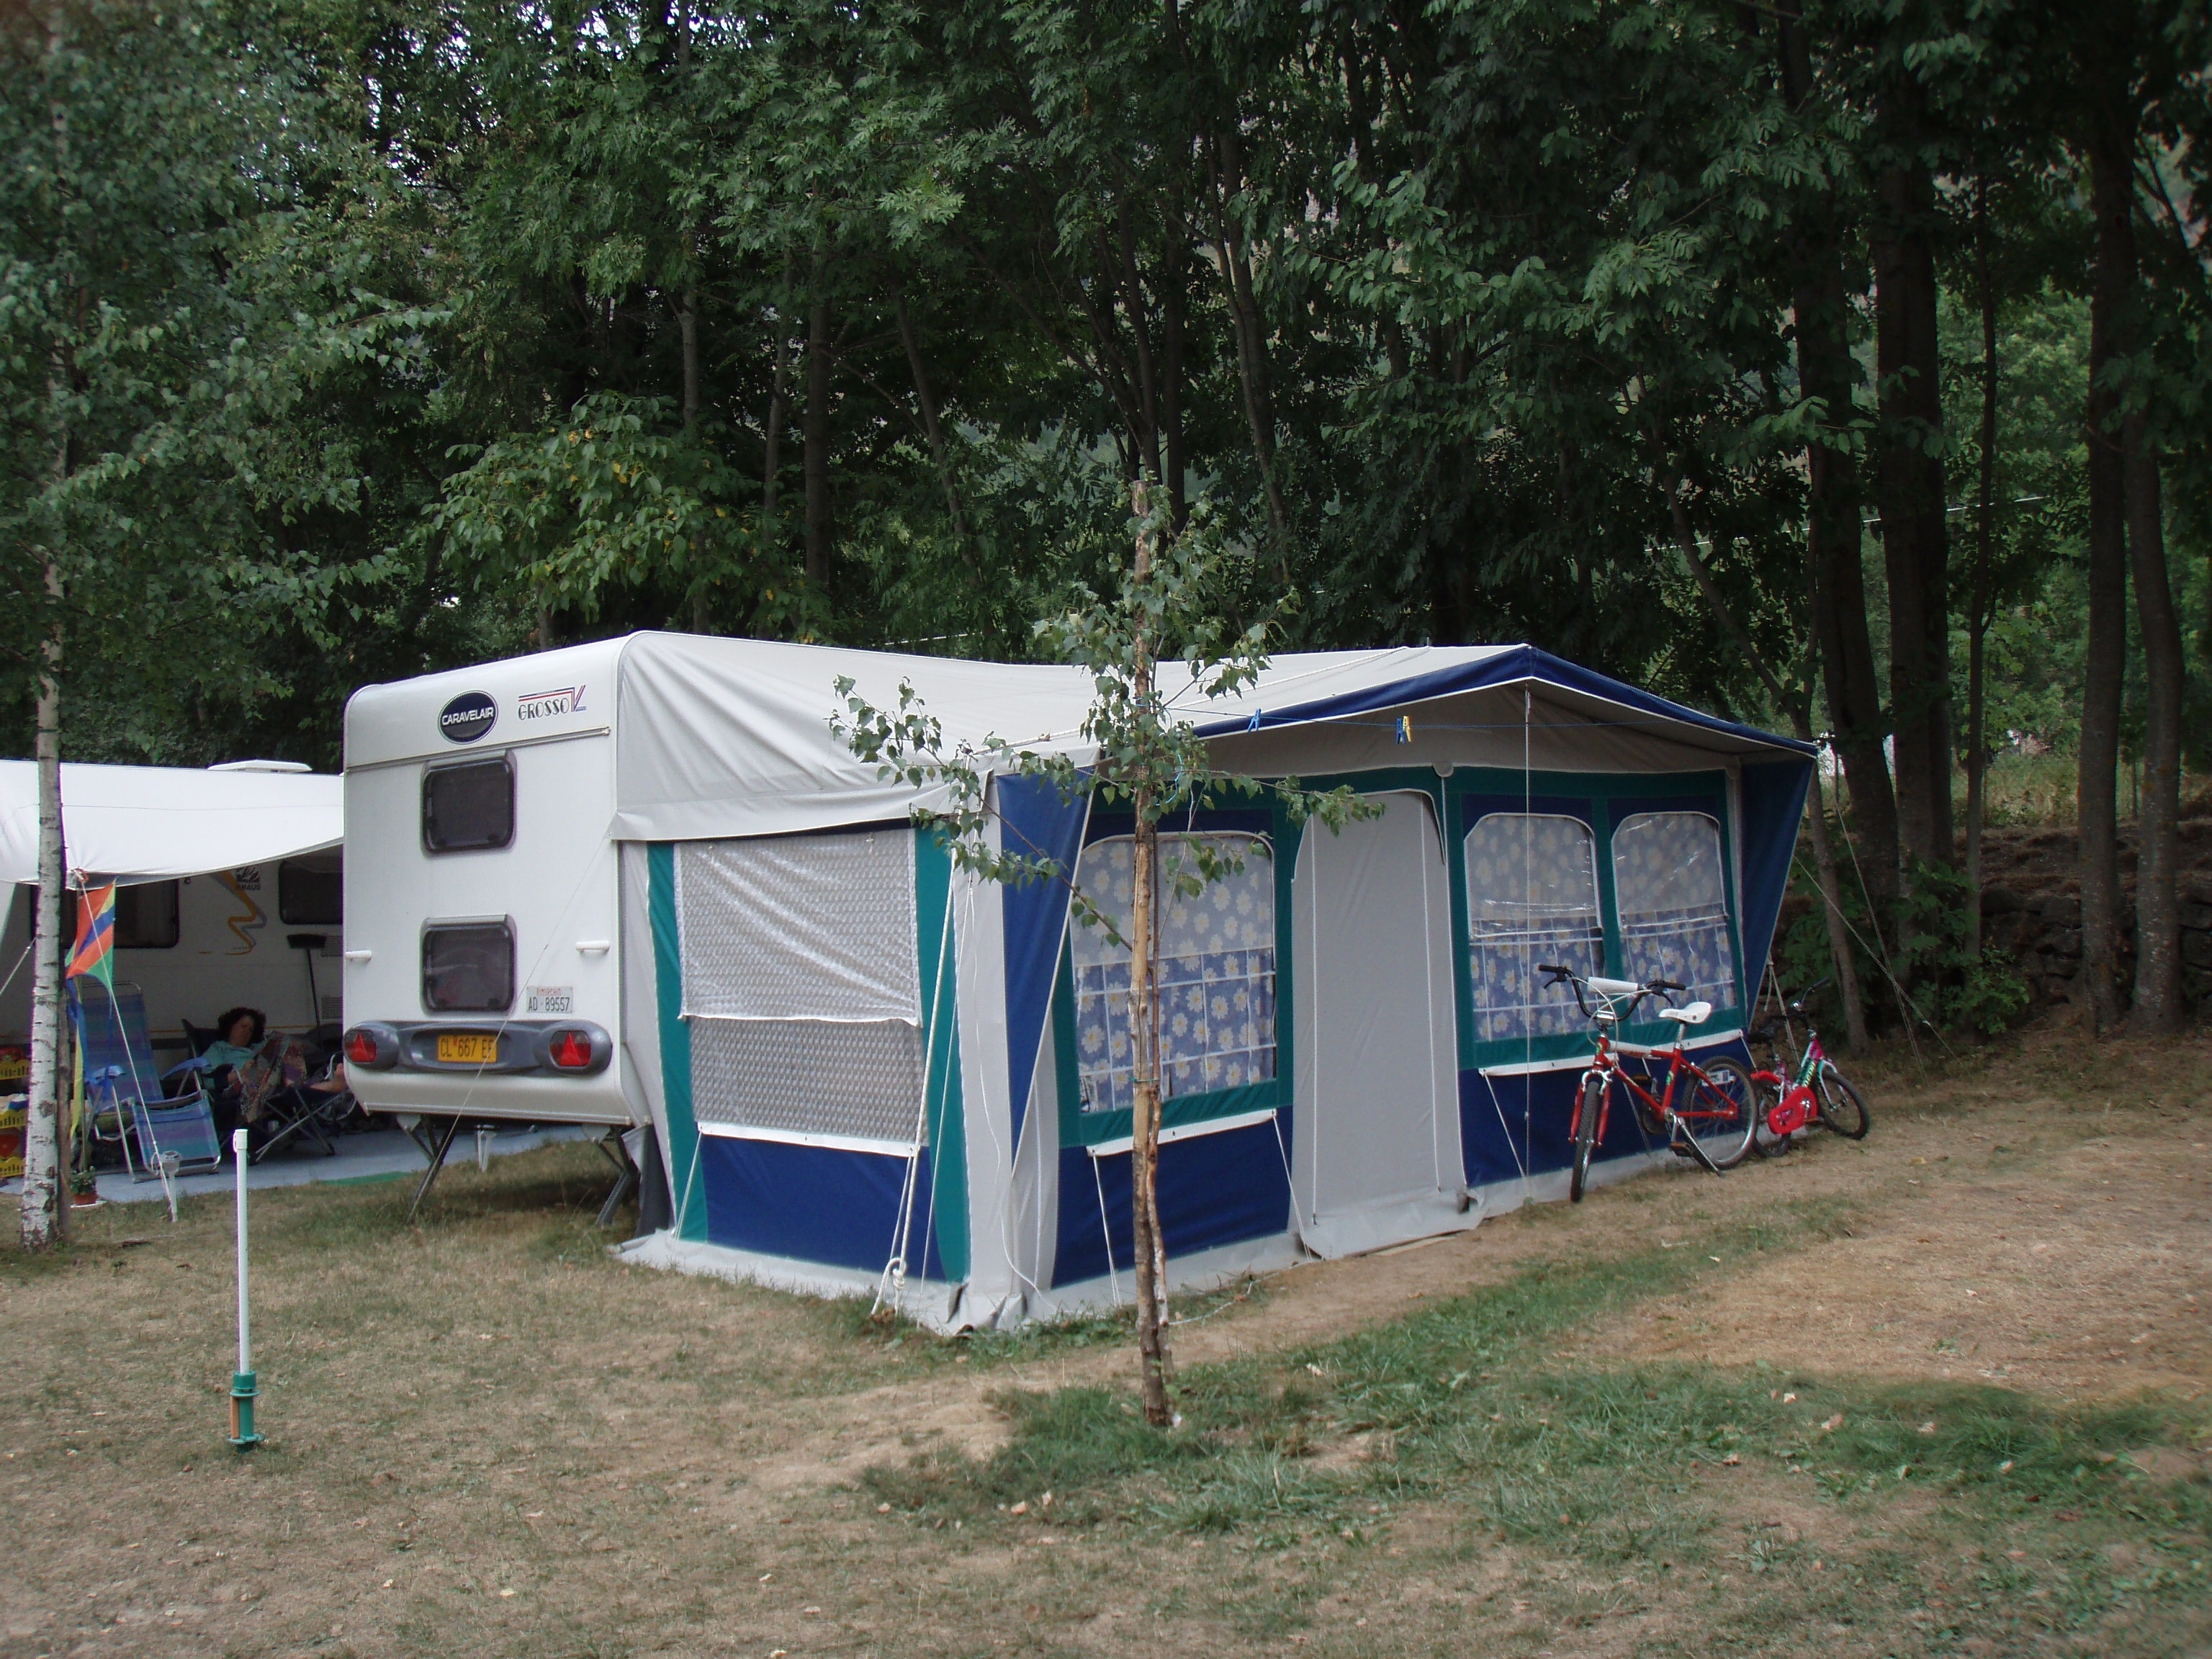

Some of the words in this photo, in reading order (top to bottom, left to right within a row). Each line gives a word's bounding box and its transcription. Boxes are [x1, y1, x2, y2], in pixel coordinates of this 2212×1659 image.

[441, 707, 494, 726] CARAVELAIR
[518, 697, 570, 721] GROSSO
[529, 997, 538, 1011] AD
[545, 997, 570, 1012] 89557
[441, 1038, 452, 1057] CL
[458, 1038, 477, 1057] 667
